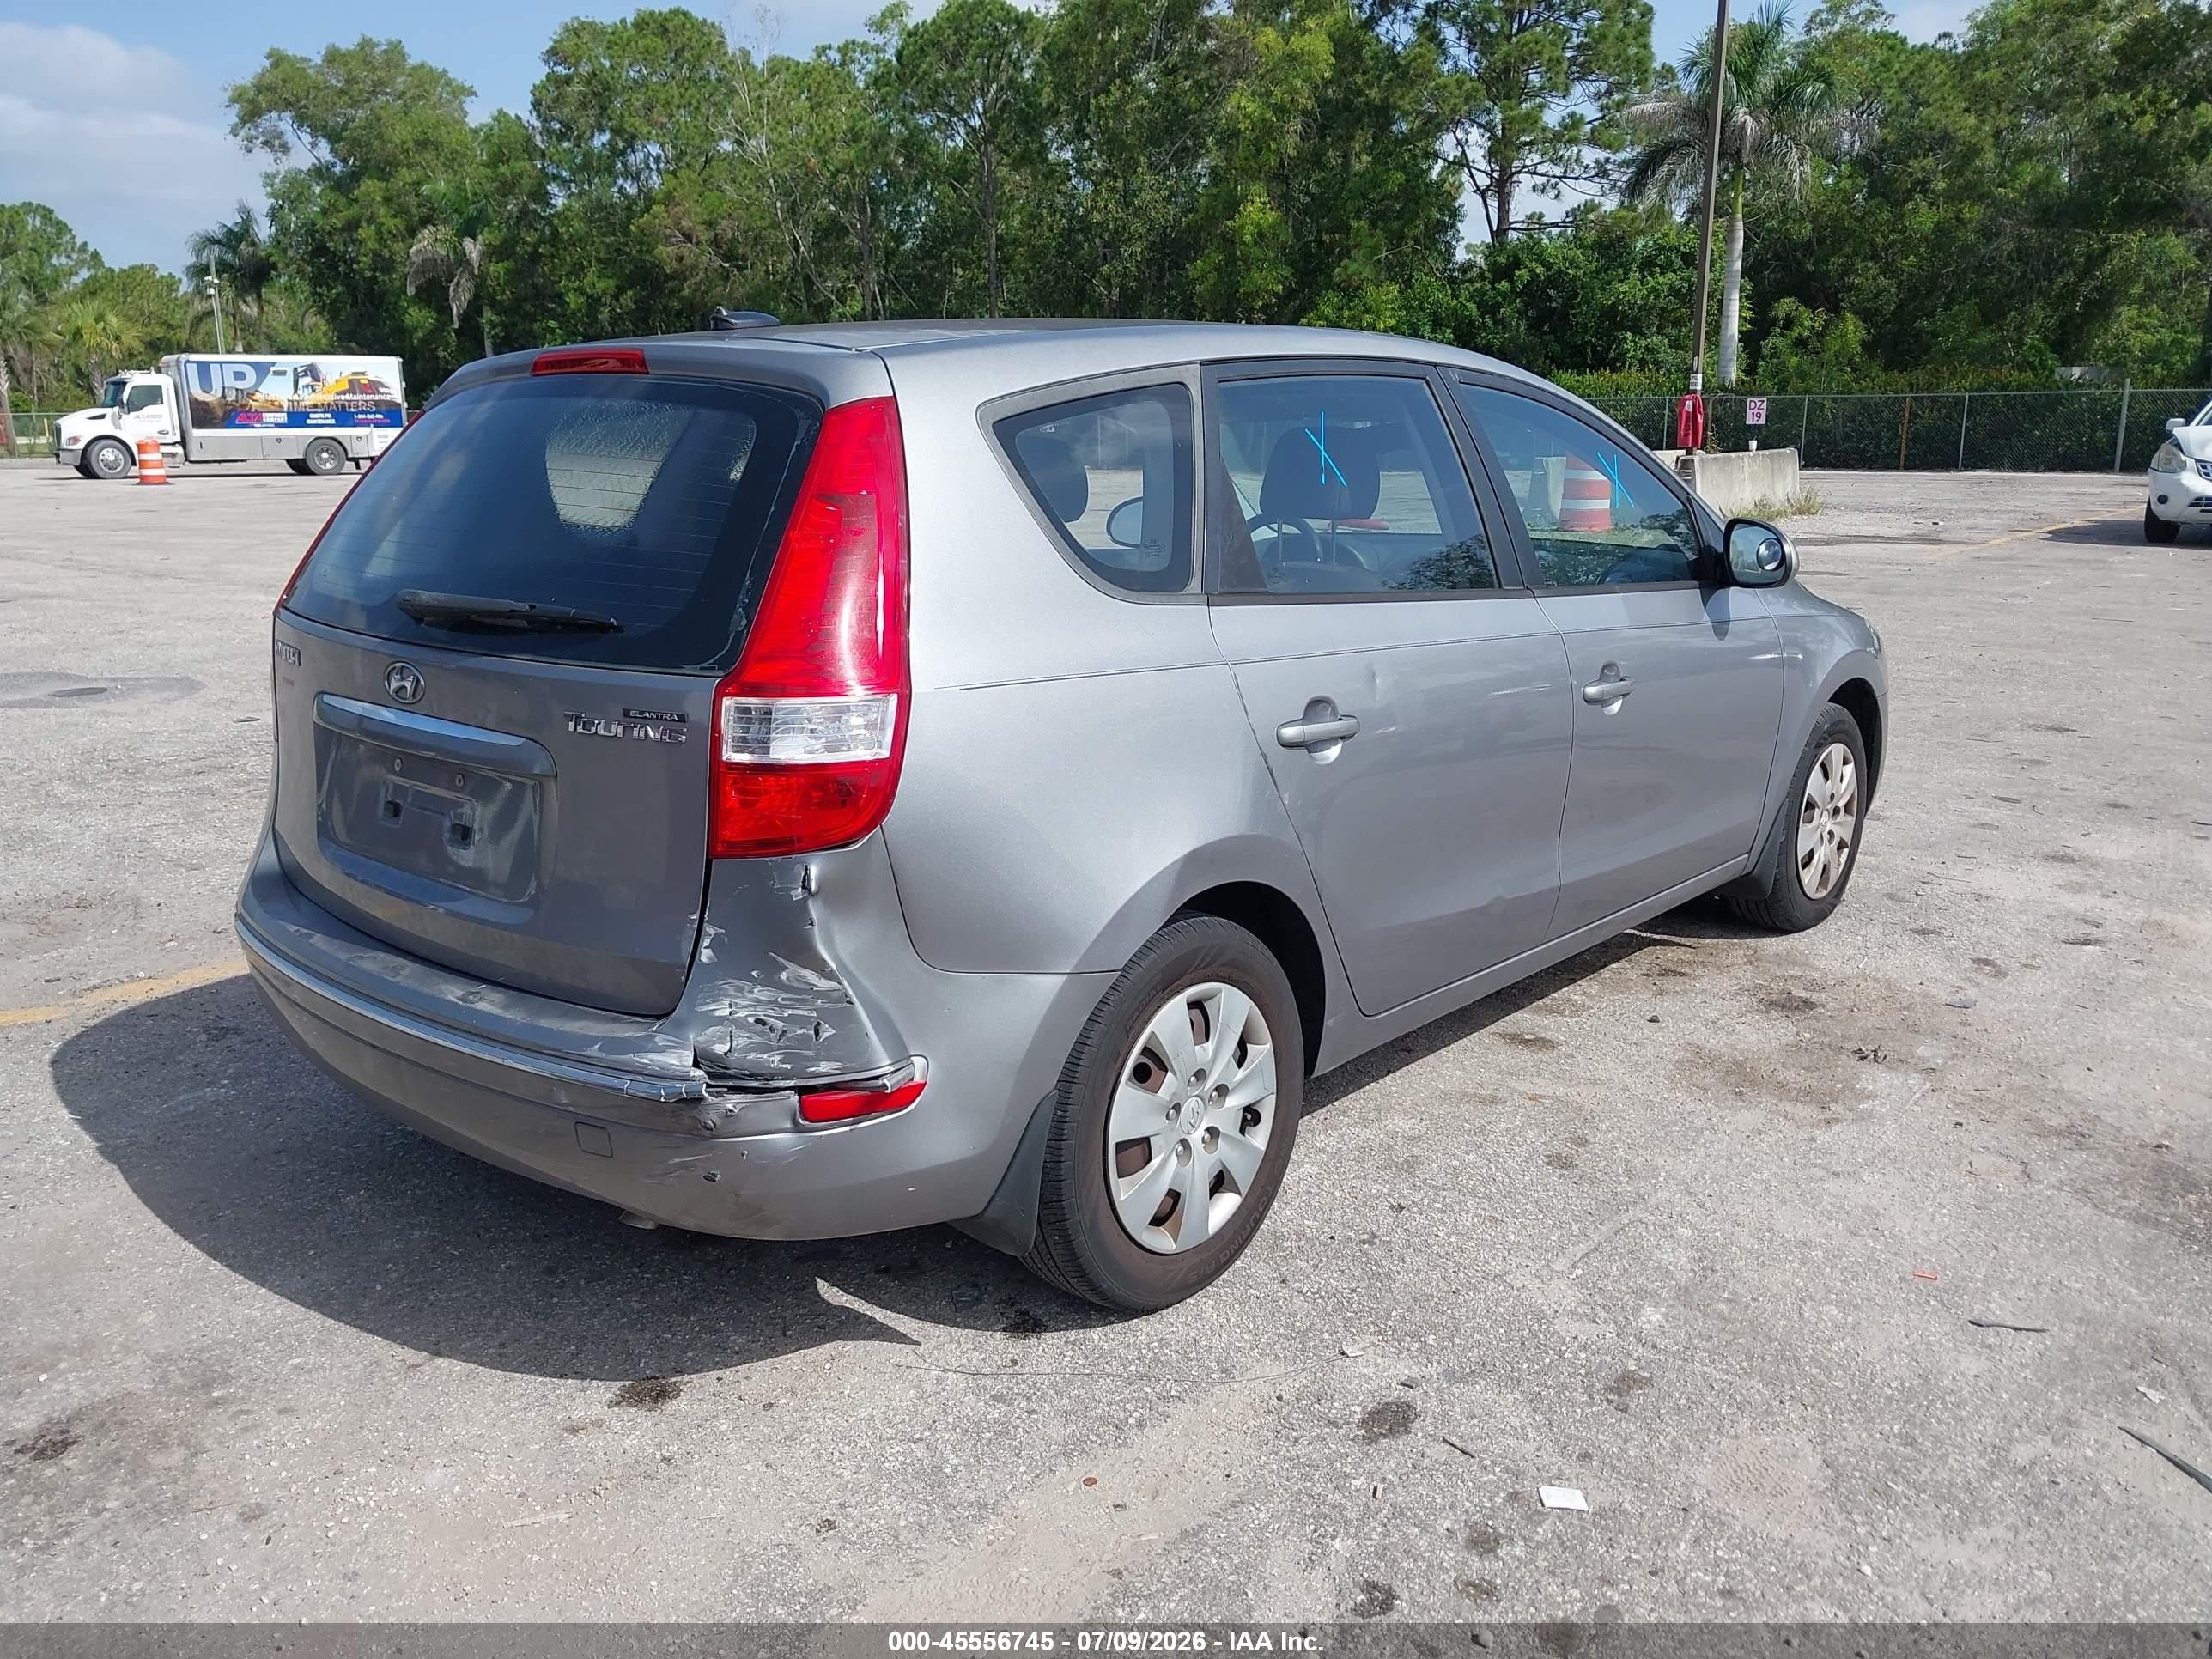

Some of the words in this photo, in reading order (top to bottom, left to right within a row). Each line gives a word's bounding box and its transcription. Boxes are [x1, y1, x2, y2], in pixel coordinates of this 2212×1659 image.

[185, 363, 257, 402] UP
[318, 400, 376, 412] MATTERS
[1748, 399, 1765, 410] DZ
[1751, 411, 1762, 422] 19
[629, 710, 678, 721] ELANTRA
